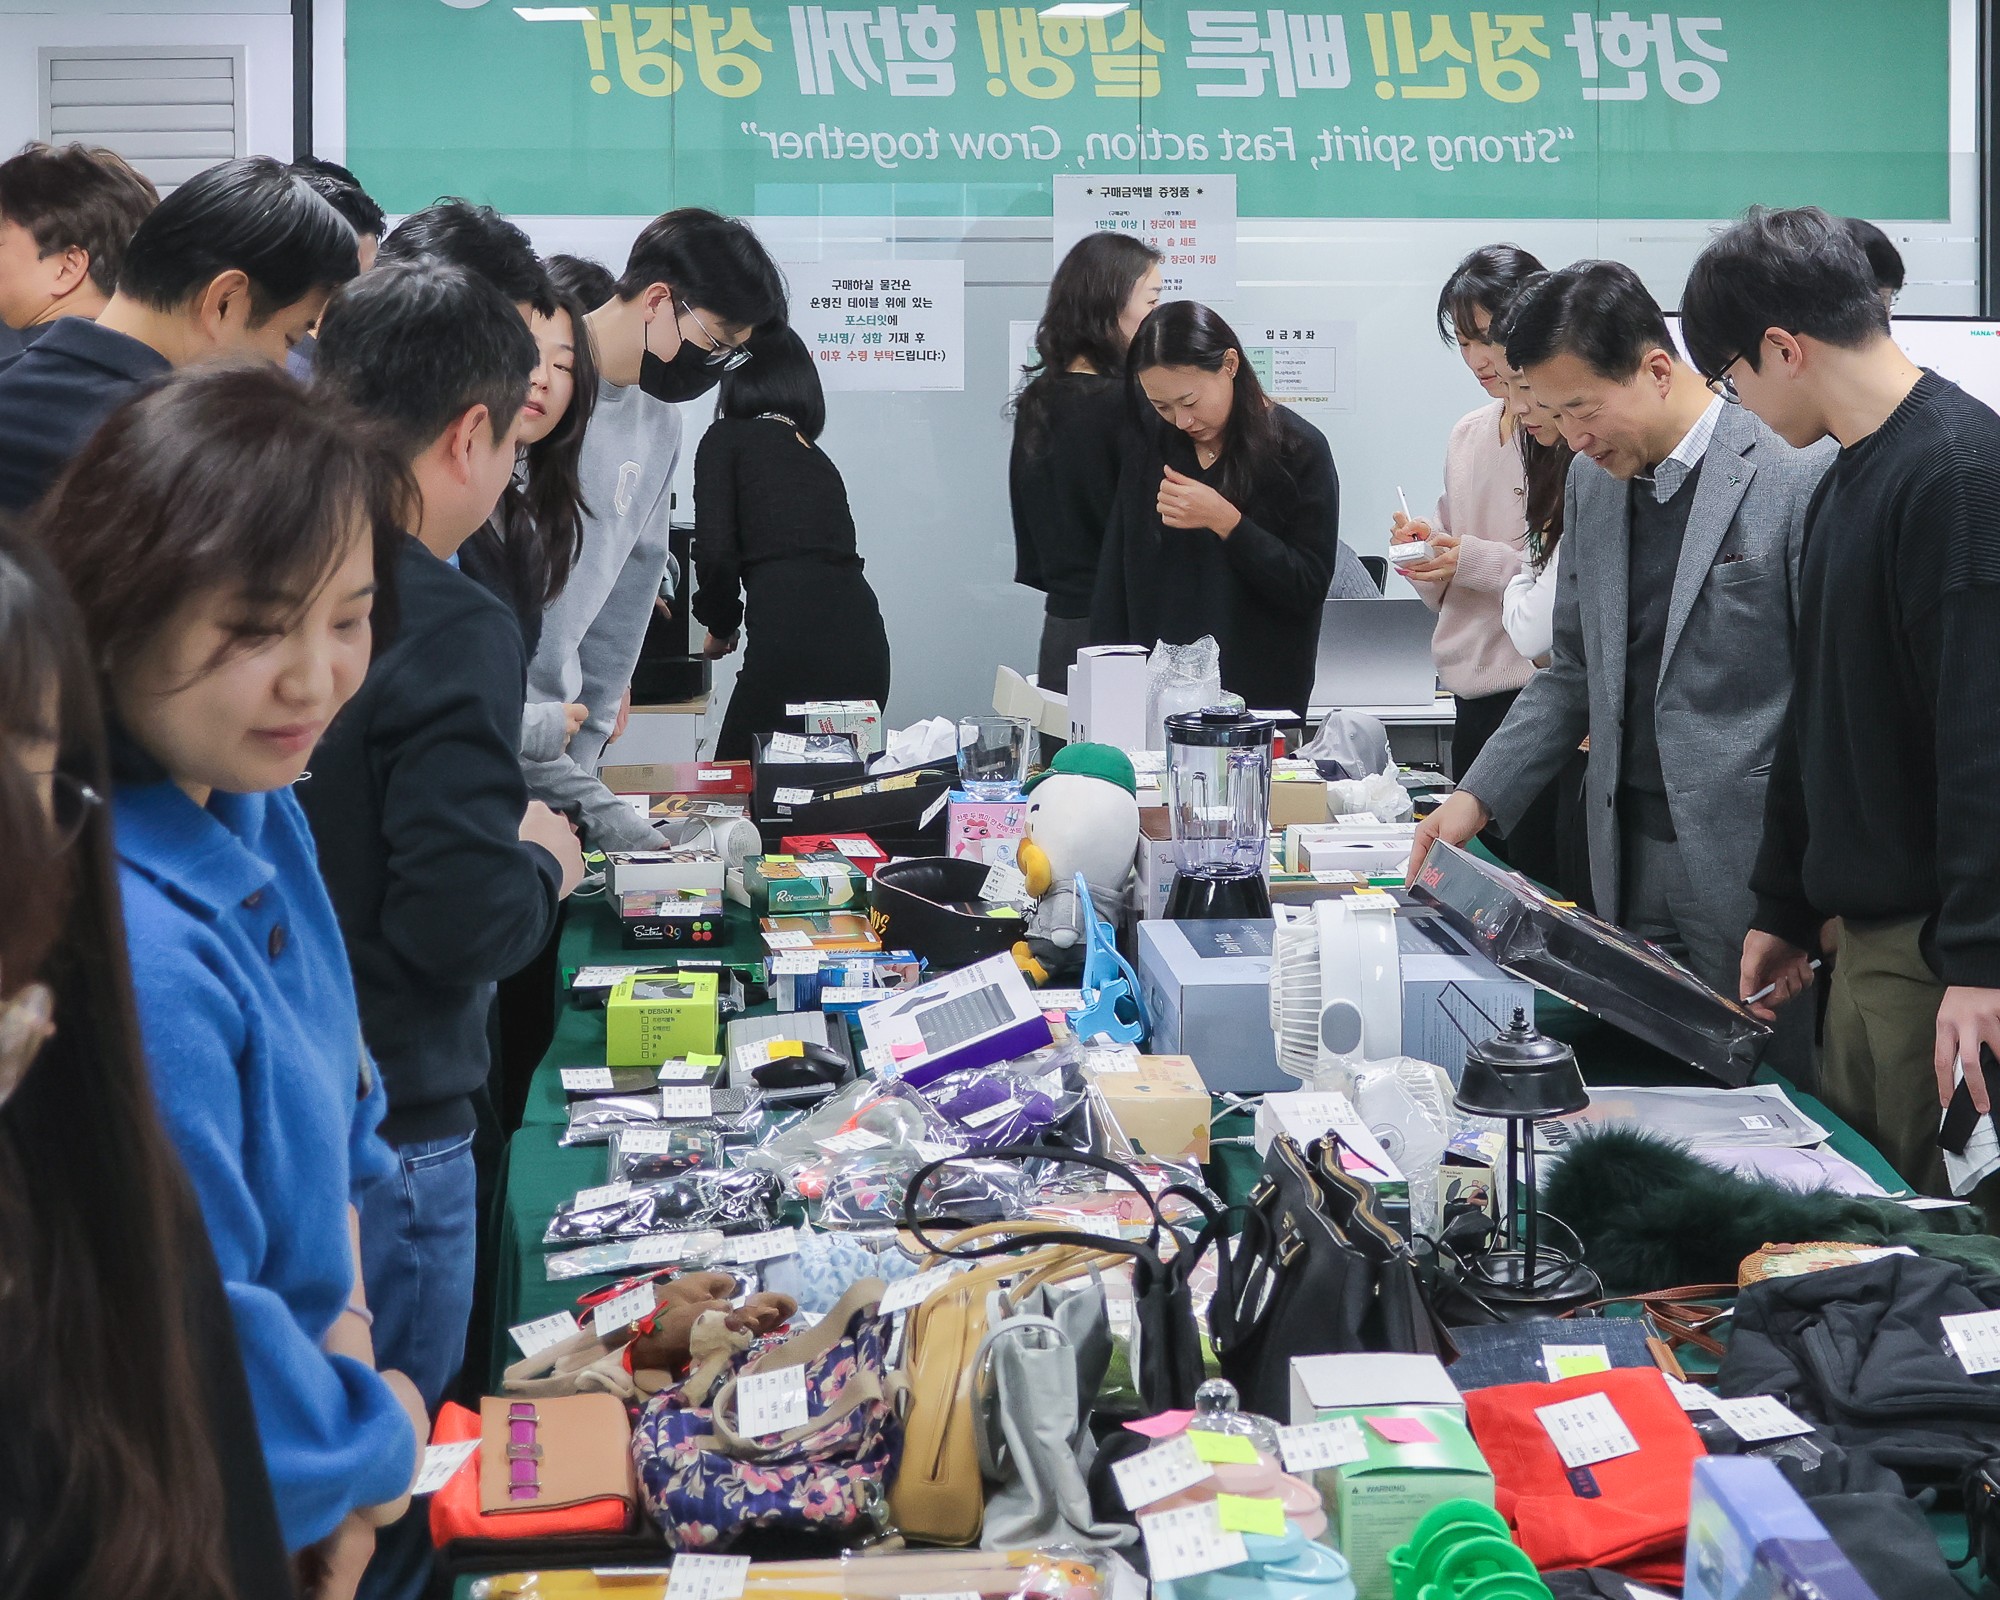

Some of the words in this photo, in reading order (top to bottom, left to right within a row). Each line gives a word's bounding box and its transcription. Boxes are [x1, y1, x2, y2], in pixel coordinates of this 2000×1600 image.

[1100, 187, 1153, 198] 구매금액별
[1158, 187, 1190, 198] 증정품
[1094, 220, 1117, 230] 1만원
[1121, 220, 1138, 229] 이상
[1150, 220, 1175, 230] 장군이
[1179, 220, 1197, 230] 볼펜
[1180, 237, 1197, 247] 세트
[1170, 255, 1195, 265] 장군이
[1200, 255, 1217, 265] 키링
[831, 279, 874, 291] 구매하실
[879, 279, 911, 291] 물건은
[809, 297, 842, 309] 운영진
[847, 297, 879, 309] 테이블
[885, 297, 906, 309] 위에
[912, 297, 933, 309] 있는
[845, 315, 898, 326] 포스터잇에
[817, 333, 855, 344] 부서명/
[862, 333, 883, 344] 성함
[888, 333, 909, 344] 기재
[914, 333, 926, 344] 후
[820, 351, 841, 362] 이후
[847, 351, 868, 362] 수령
[1419, 862, 1445, 889] Tefal
[1366, 1485, 1406, 1493] WARNING
